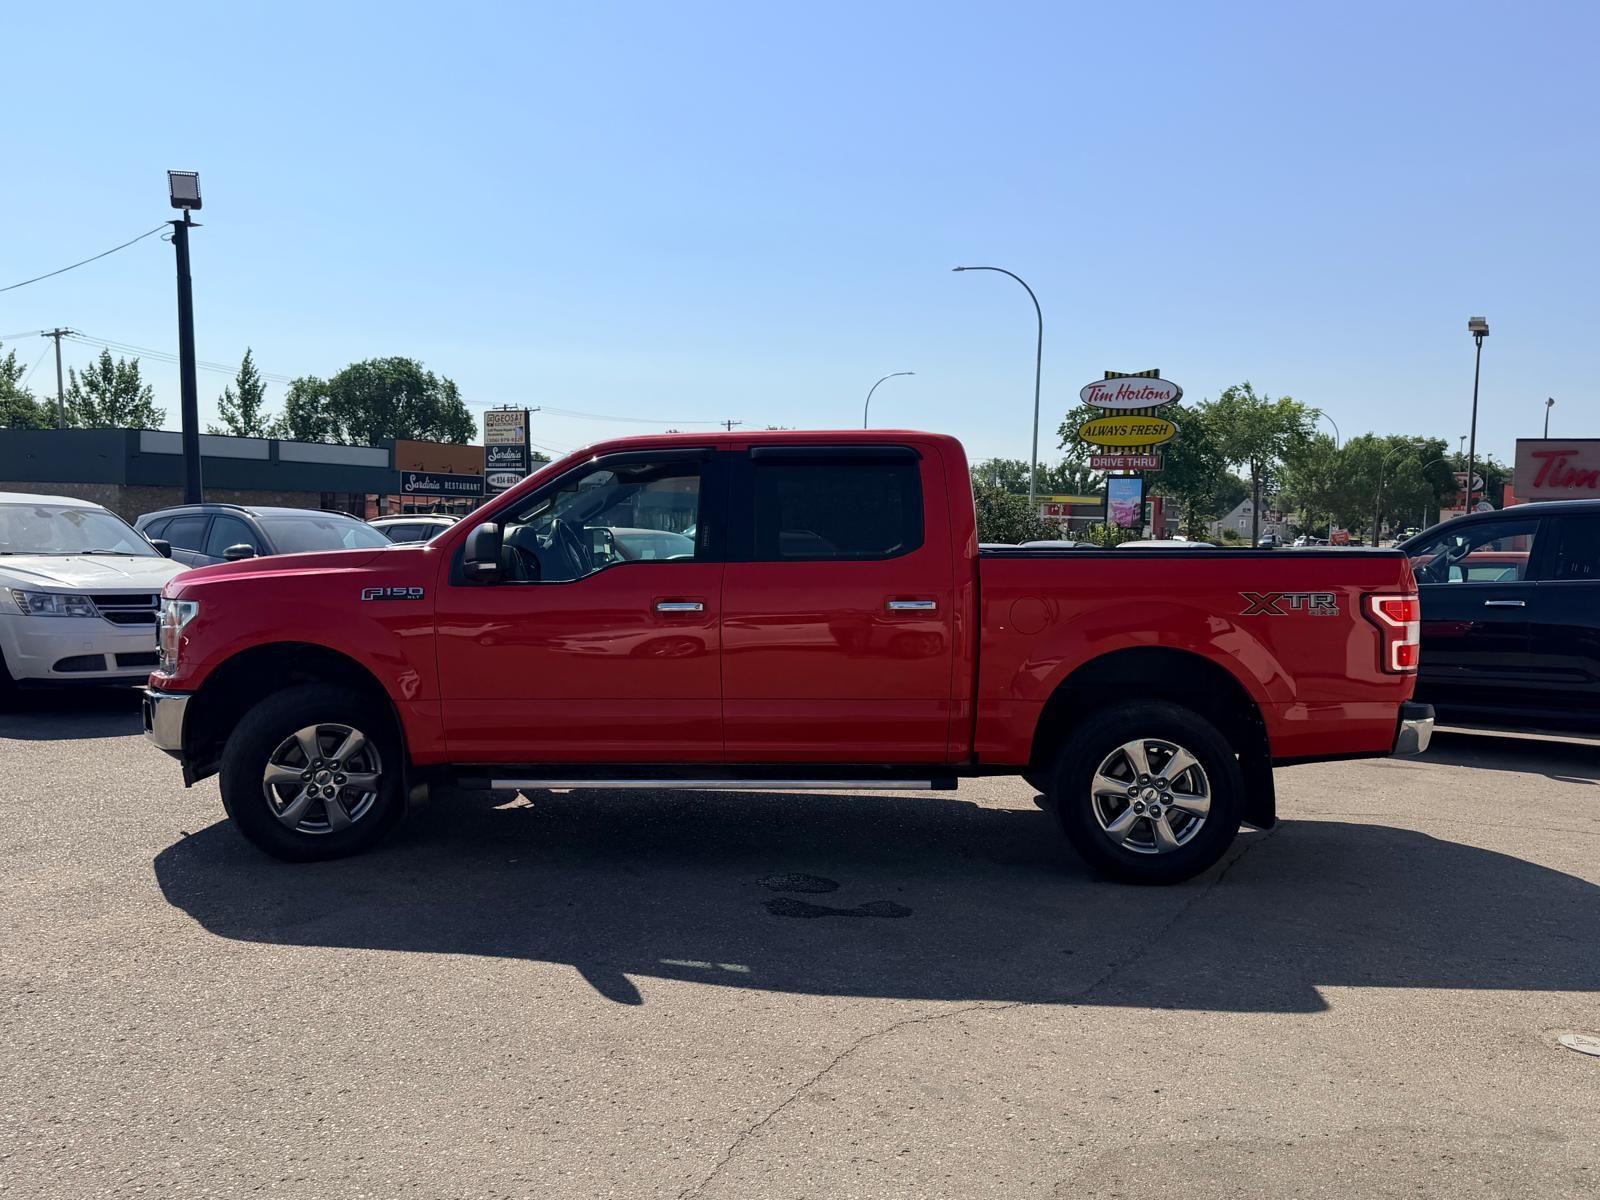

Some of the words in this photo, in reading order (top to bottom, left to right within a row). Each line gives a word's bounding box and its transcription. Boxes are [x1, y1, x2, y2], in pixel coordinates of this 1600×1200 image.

[1088, 385, 1113, 402] Tim
[1116, 383, 1170, 400] Hortons
[494, 413, 522, 423] GEOSAT
[1083, 425, 1128, 437] ALWAYS
[1129, 424, 1169, 436] FRESH
[488, 447, 521, 461] Sardinia
[1093, 457, 1124, 467] DRIVE
[1127, 457, 1156, 467] THRU
[1531, 450, 1600, 489] Tim
[405, 474, 440, 491] Sardinia
[444, 481, 481, 491] RESTAURANT
[1237, 591, 1339, 616] XTR
